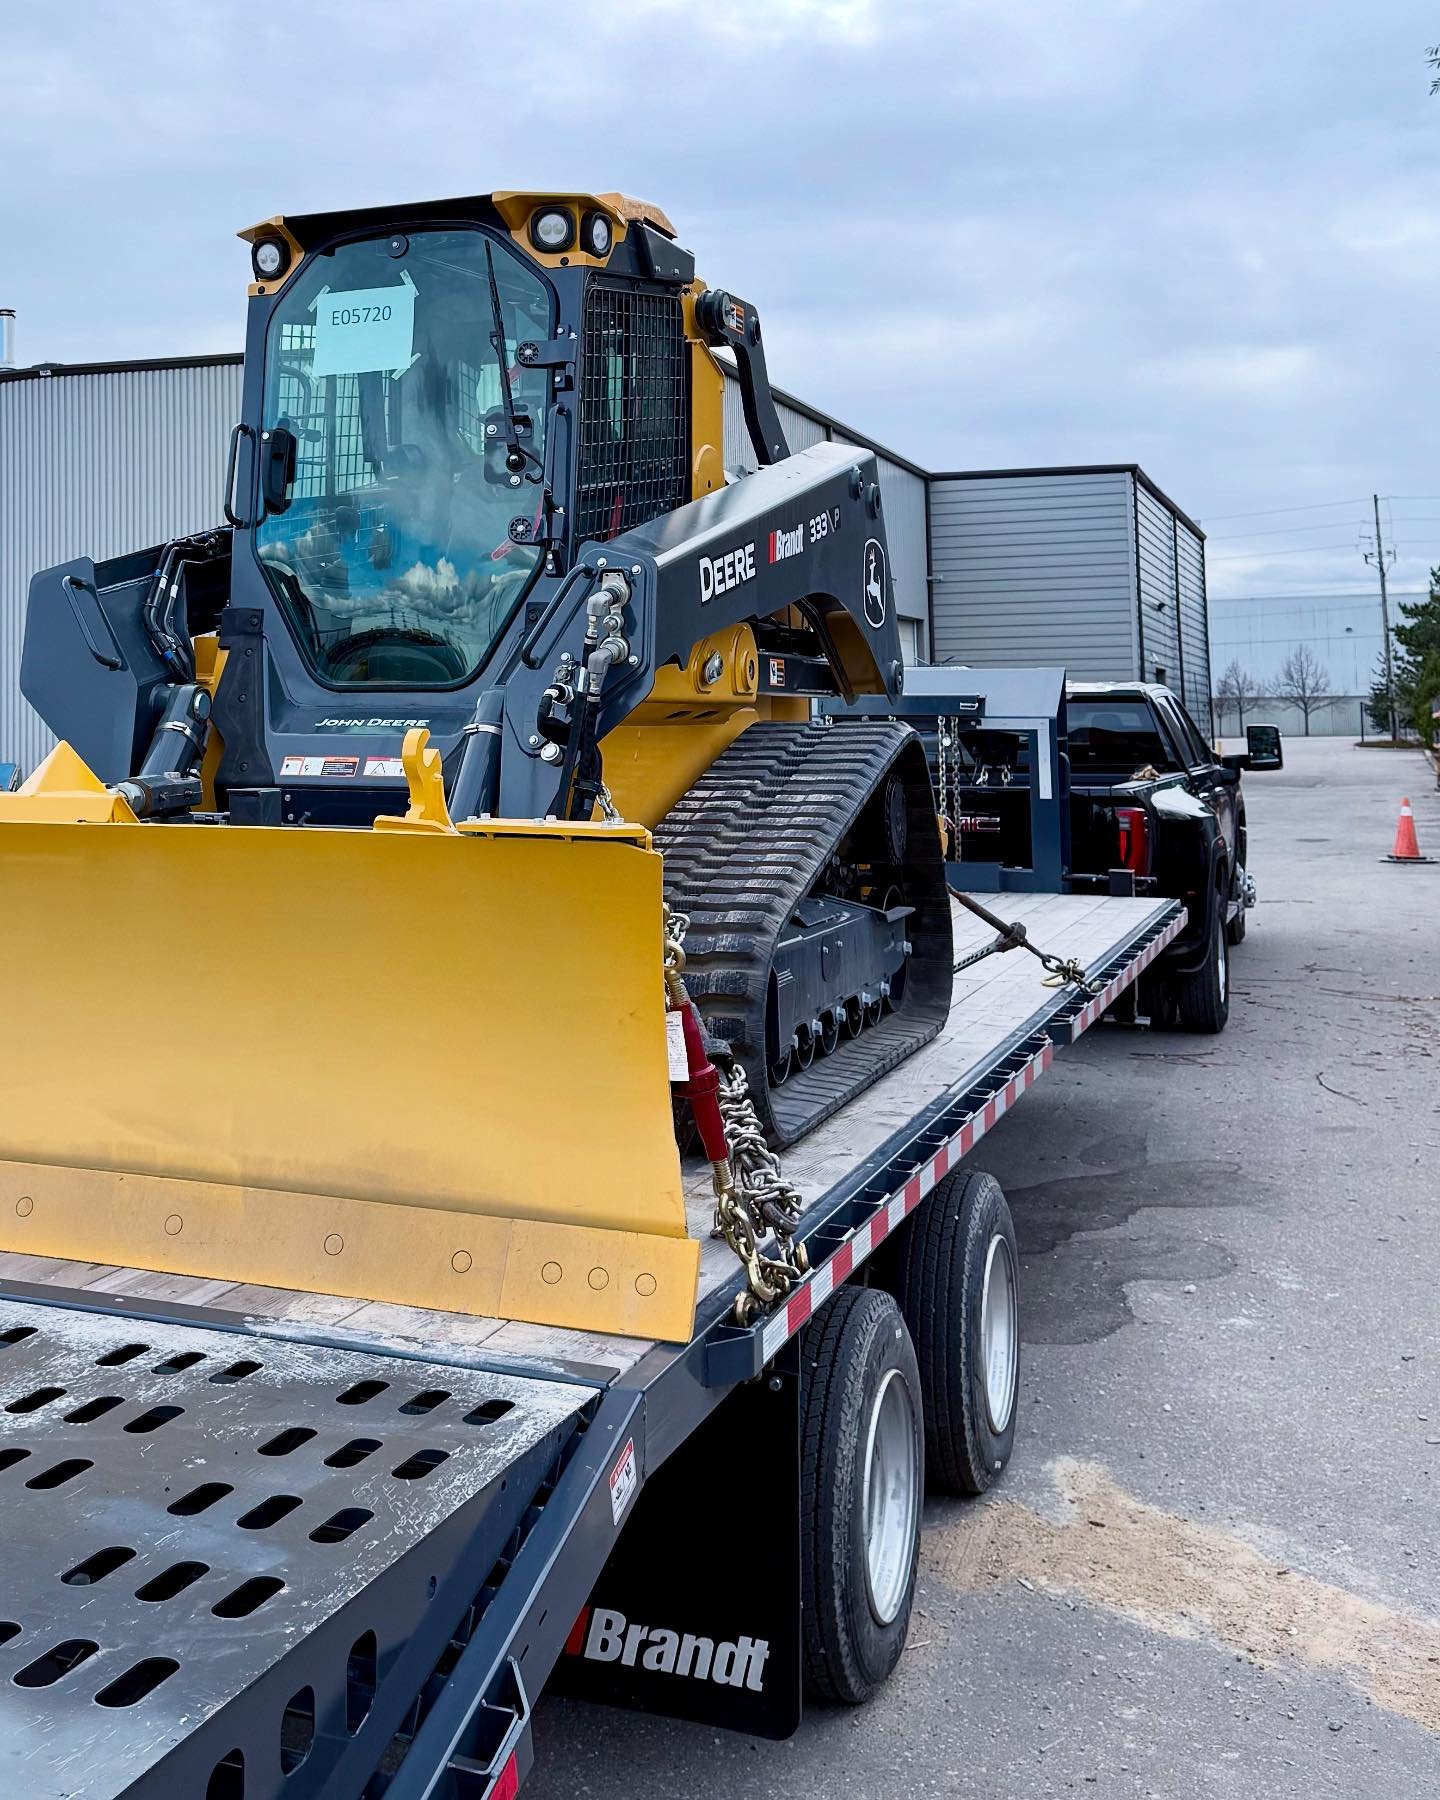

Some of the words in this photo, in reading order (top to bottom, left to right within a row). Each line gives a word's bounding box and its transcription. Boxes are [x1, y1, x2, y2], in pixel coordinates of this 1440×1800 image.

[332, 305, 392, 326] E05720
[699, 542, 757, 603] DEERE
[775, 523, 804, 562] Brandt
[314, 718, 365, 727] JOHN
[366, 718, 430, 728] DEERE
[943, 816, 1001, 833] MC
[583, 1607, 770, 1692] Brandt
